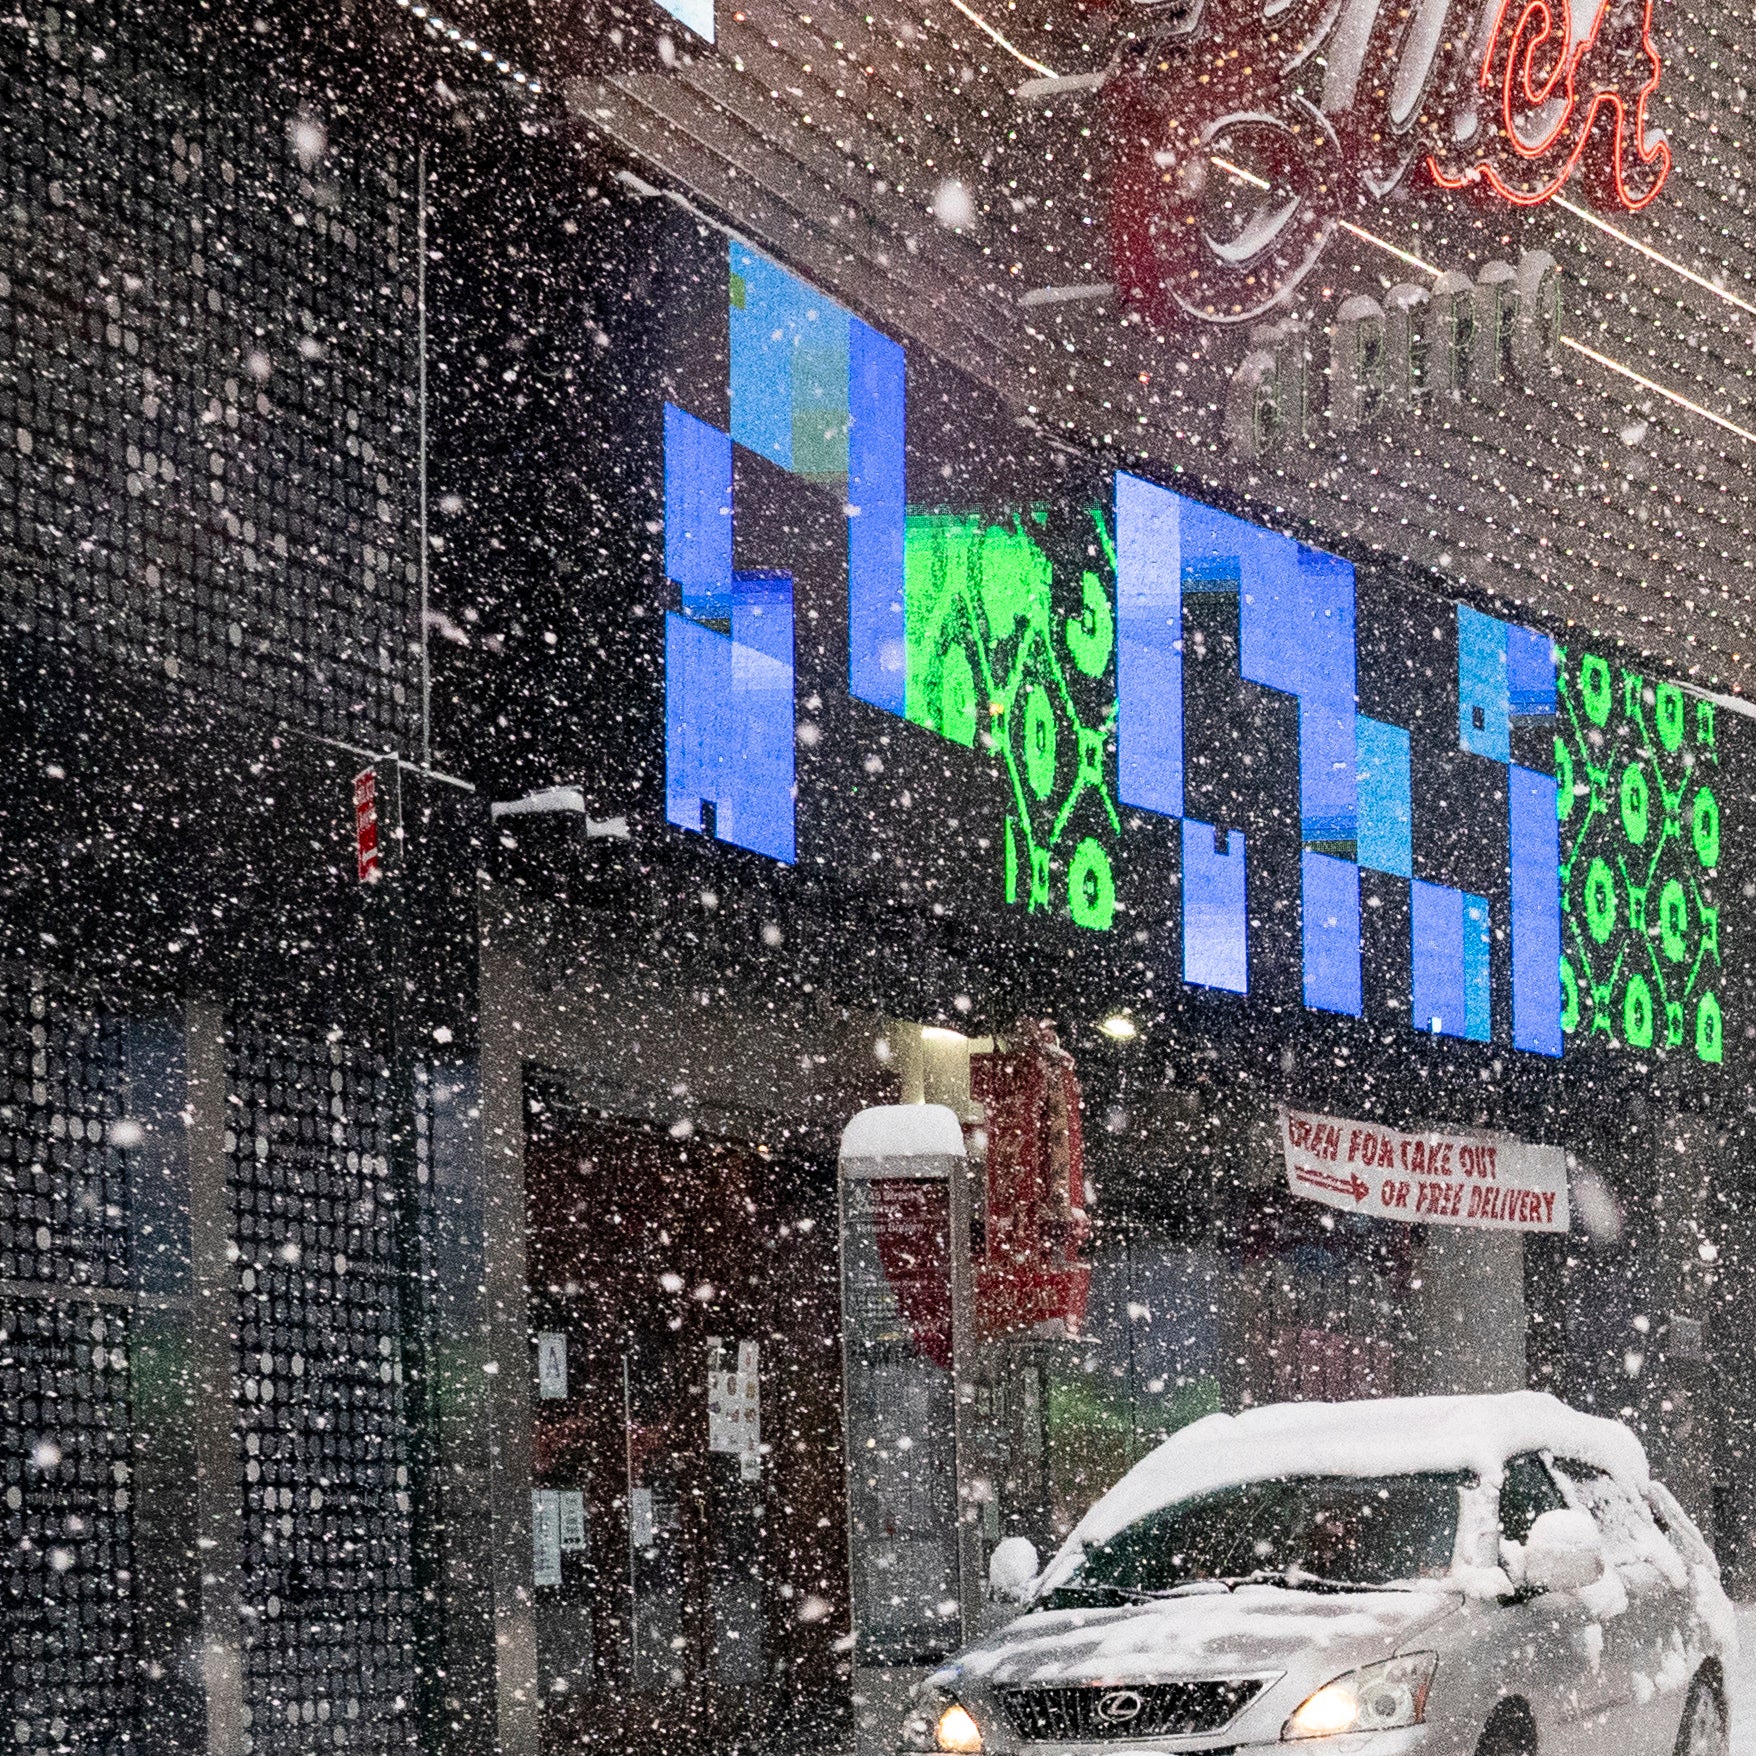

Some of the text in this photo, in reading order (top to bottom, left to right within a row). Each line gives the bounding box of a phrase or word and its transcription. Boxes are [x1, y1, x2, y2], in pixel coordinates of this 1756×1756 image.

[1348, 1130, 1394, 1168] FOR
[1400, 1140, 1454, 1175] TAKE
[1459, 1145, 1497, 1179] OUT
[1380, 1179, 1557, 1224] OR FREE DELIVERY
